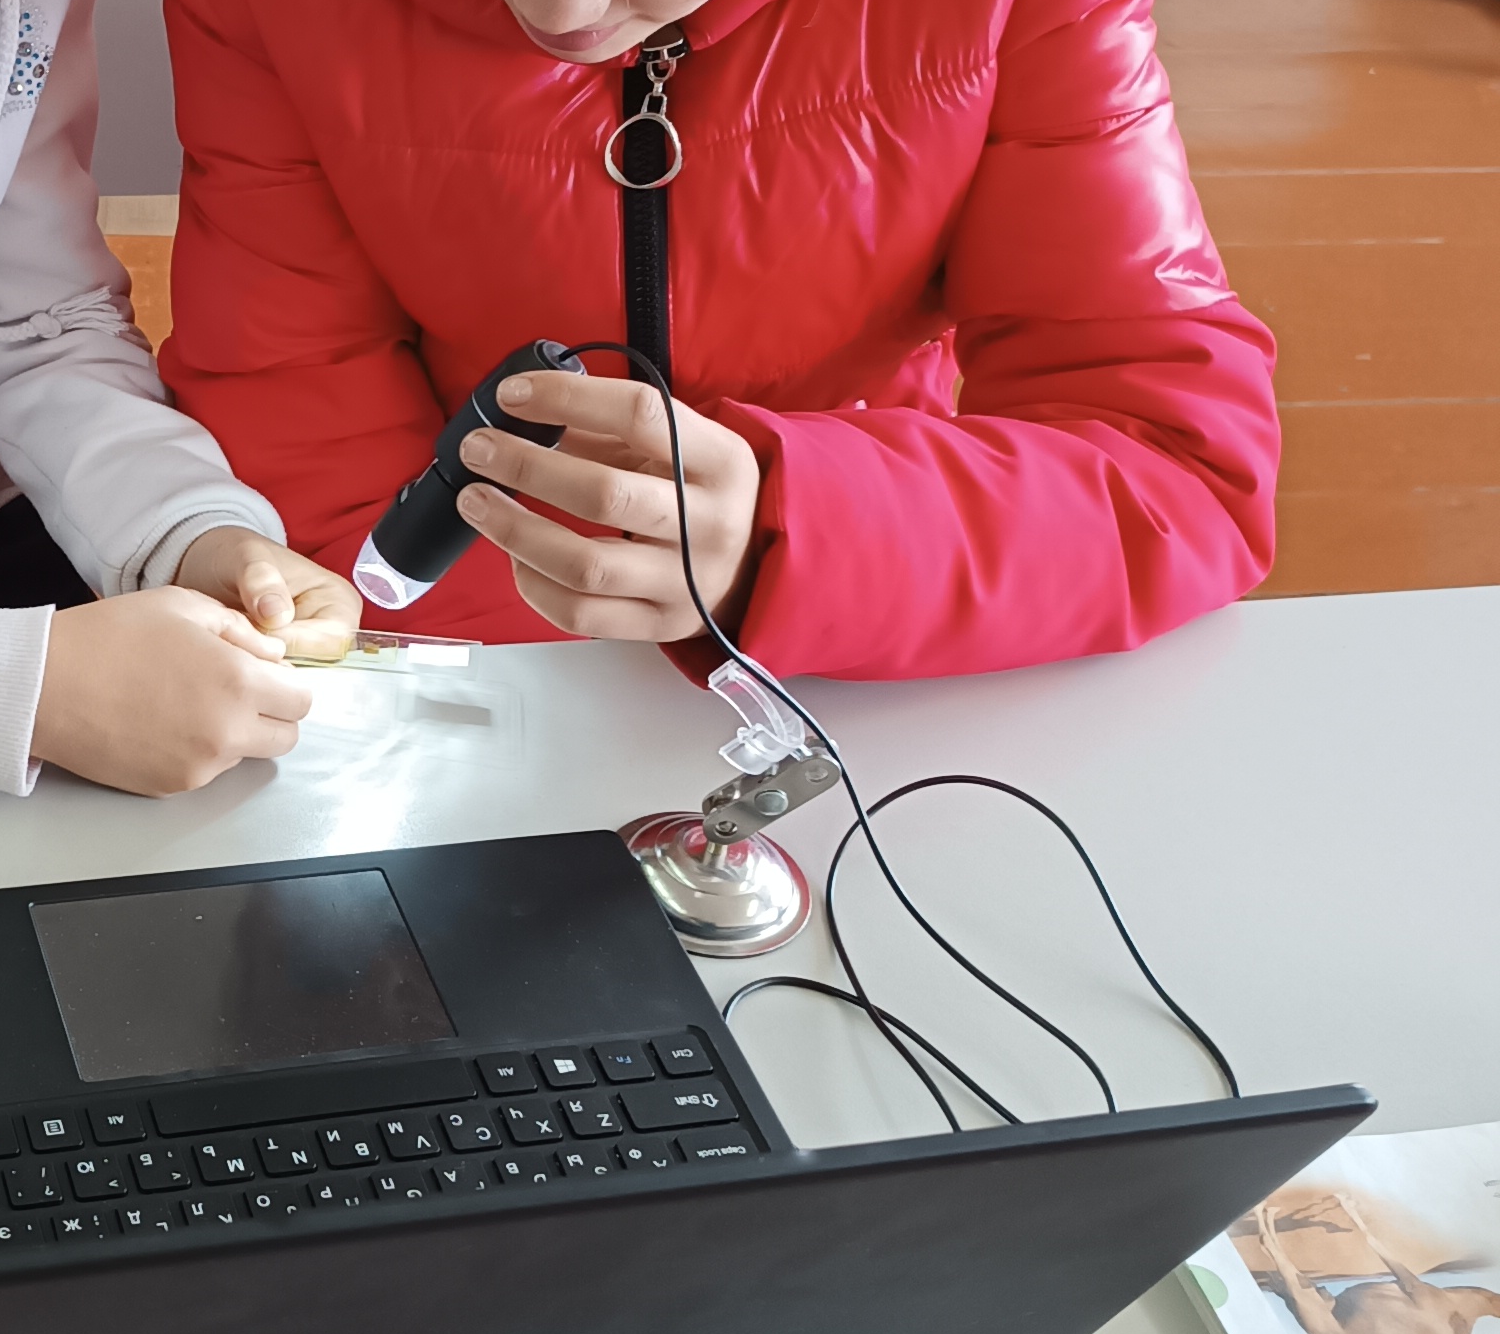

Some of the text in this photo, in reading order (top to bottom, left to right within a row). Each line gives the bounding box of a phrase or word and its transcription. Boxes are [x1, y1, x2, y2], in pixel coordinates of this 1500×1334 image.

[616, 1055, 631, 1063] Fn
[672, 1049, 693, 1058] Ctrl
[498, 1067, 514, 1077] Alt
[674, 1095, 700, 1105] Shift
[569, 1101, 583, 1112] Я
[108, 1115, 124, 1124] Alt
[509, 1108, 523, 1119] Ч
[597, 1113, 612, 1126] Z
[536, 1120, 552, 1133] X
[326, 1130, 340, 1142] И
[476, 1128, 491, 1140] C
[417, 1135, 431, 1148] V
[292, 1151, 307, 1164] N
[629, 1149, 642, 1159] Ф
[697, 1146, 746, 1159] Caps Lock
[140, 1154, 152, 1165] Б
[567, 1155, 583, 1166] Ы
[77, 1161, 94, 1173] Ю
[381, 1178, 395, 1190] П
[192, 1203, 203, 1215] Л
[127, 1211, 141, 1224] Д
[63, 1219, 82, 1231] Ж
